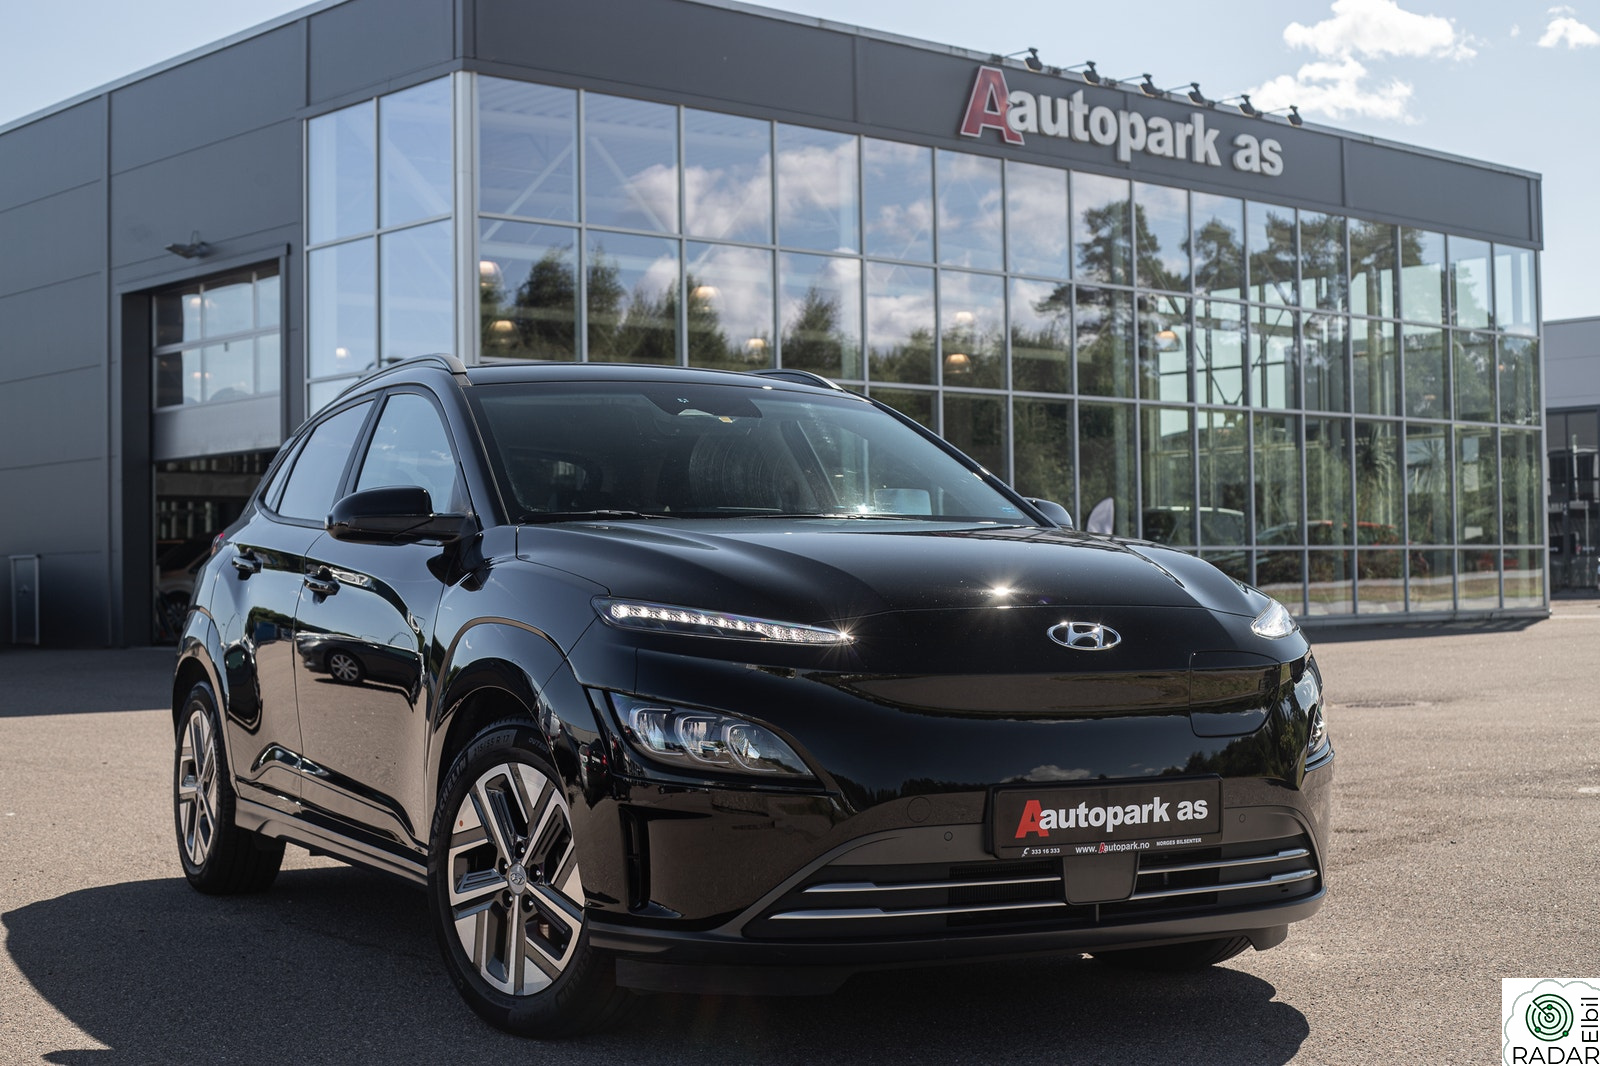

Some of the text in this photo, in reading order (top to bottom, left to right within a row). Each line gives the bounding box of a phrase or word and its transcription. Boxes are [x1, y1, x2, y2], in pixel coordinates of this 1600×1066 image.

[1232, 133, 1285, 176] as
[433, 756, 467, 834] MICHELIN
[1177, 799, 1209, 821] as
[1156, 837, 1202, 847] NORGES BILSENTER
